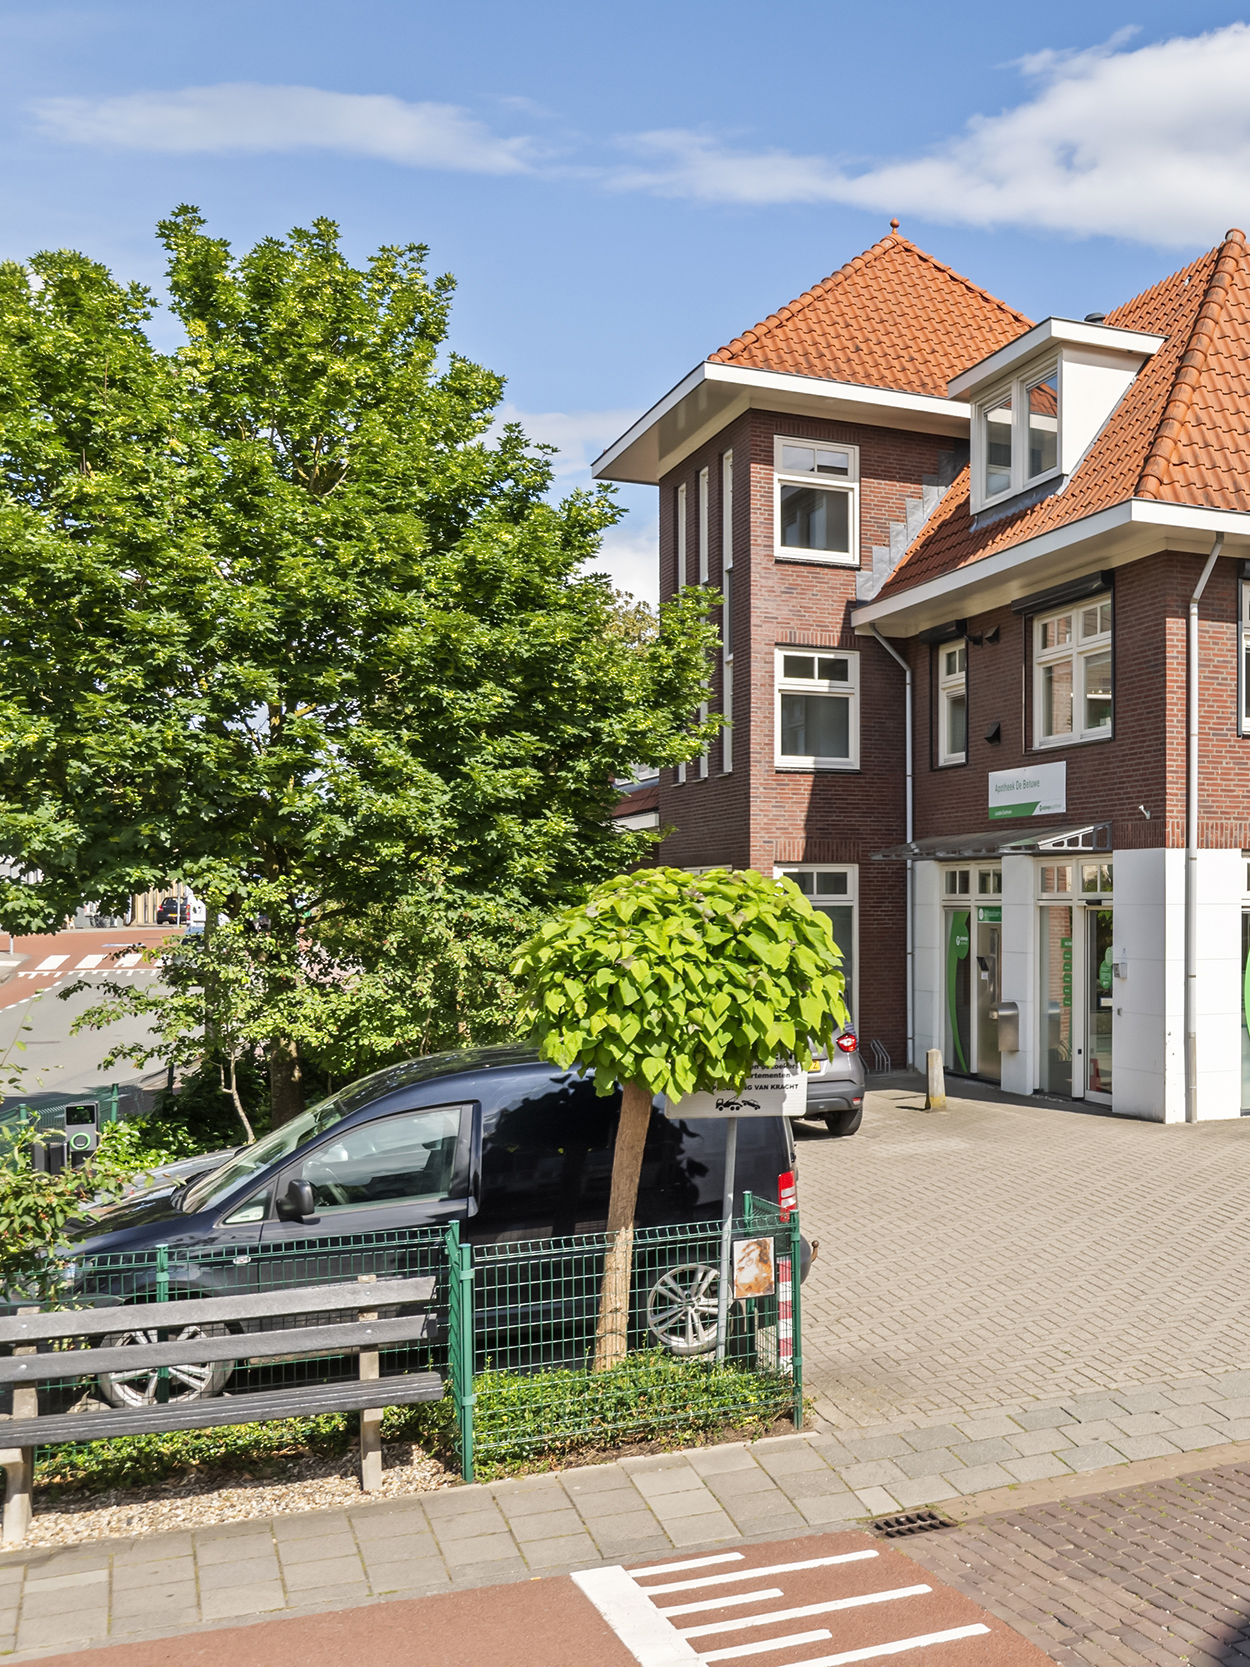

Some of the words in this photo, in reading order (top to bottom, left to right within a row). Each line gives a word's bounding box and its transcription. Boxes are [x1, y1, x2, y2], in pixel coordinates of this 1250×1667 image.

[995, 782, 1015, 794] Apotheek
[1016, 780, 1022, 790] De
[1023, 779, 1040, 789] Betuwe
